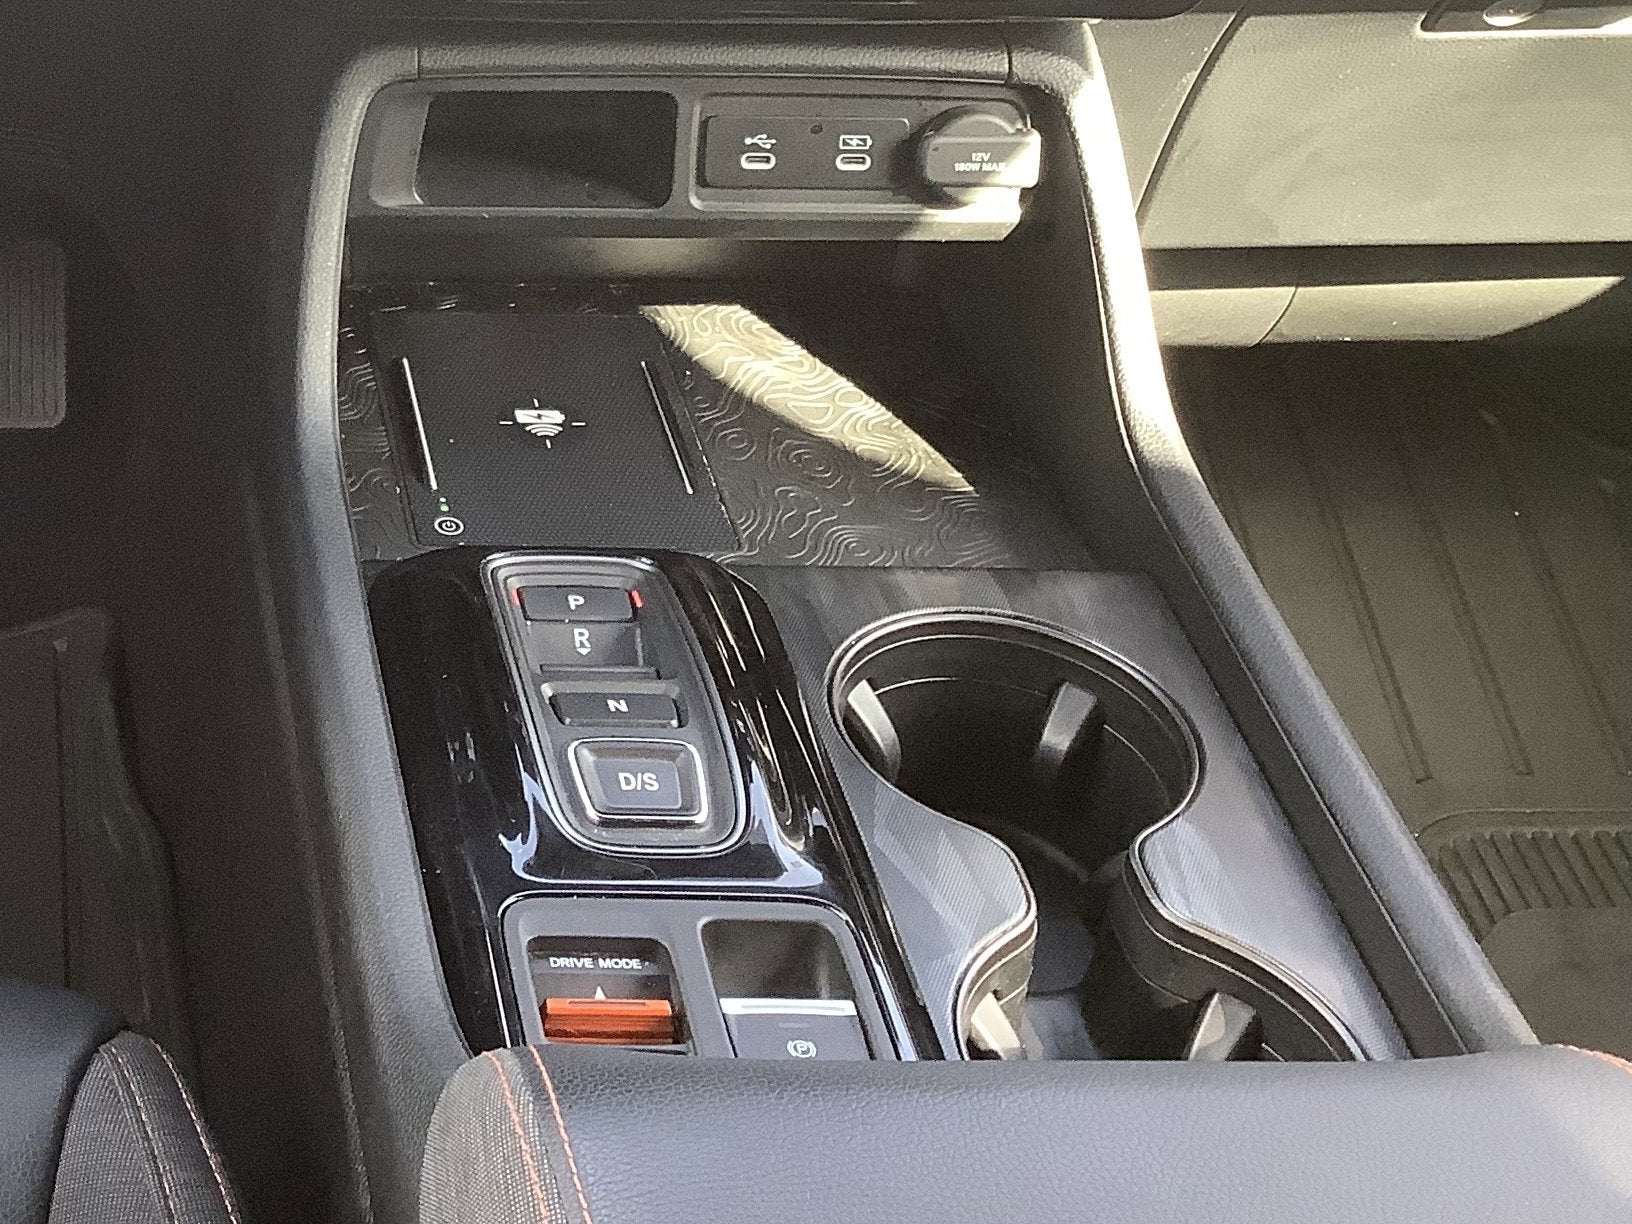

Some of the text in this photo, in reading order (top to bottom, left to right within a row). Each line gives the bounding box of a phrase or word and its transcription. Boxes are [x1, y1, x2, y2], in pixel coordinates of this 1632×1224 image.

[971, 152, 991, 162] 12V
[568, 595, 585, 610] P
[573, 629, 591, 648] R
[607, 700, 629, 713] N
[618, 773, 660, 791] D/S
[549, 957, 642, 969] DRIVE MODE
